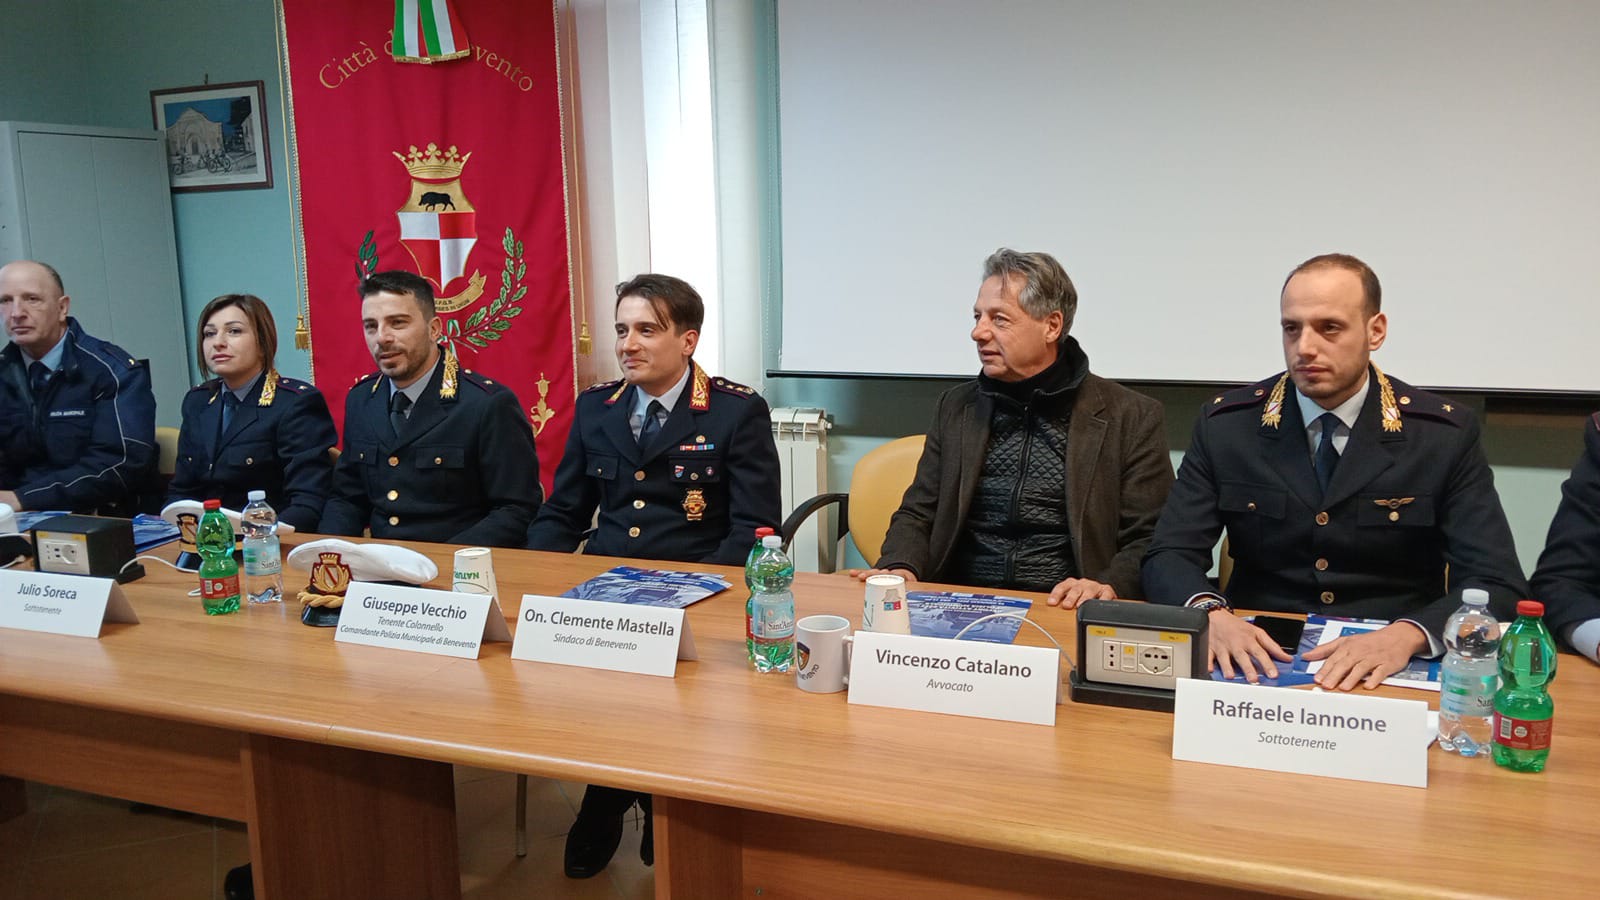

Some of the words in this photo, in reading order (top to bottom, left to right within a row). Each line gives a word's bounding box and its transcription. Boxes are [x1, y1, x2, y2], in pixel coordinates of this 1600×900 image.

[319, 41, 379, 89] Città
[17, 583, 41, 597] Julio
[42, 585, 77, 600] Soreca
[363, 596, 418, 616] Giuseppe
[421, 602, 467, 620] Vecchio
[377, 616, 405, 628] Tenente
[405, 619, 444, 632] Colonnello
[524, 608, 547, 624] On.
[550, 611, 614, 630] Clemente
[616, 617, 675, 637] Mastella
[340, 624, 379, 637] Comandante
[379, 627, 401, 640] Polizia
[401, 632, 435, 645] Municipale
[435, 636, 443, 645] di
[443, 637, 477, 649] Benevento
[553, 633, 585, 646] Sindaco
[585, 634, 594, 646] di
[595, 638, 637, 651] Benevento
[876, 649, 950, 670] Vincenzo
[955, 656, 1032, 678] Catalano
[926, 678, 974, 693] Avvocato
[1212, 699, 1294, 724] Raffaele
[1300, 708, 1387, 732] Iannone
[1257, 731, 1337, 751] Sottotenente
